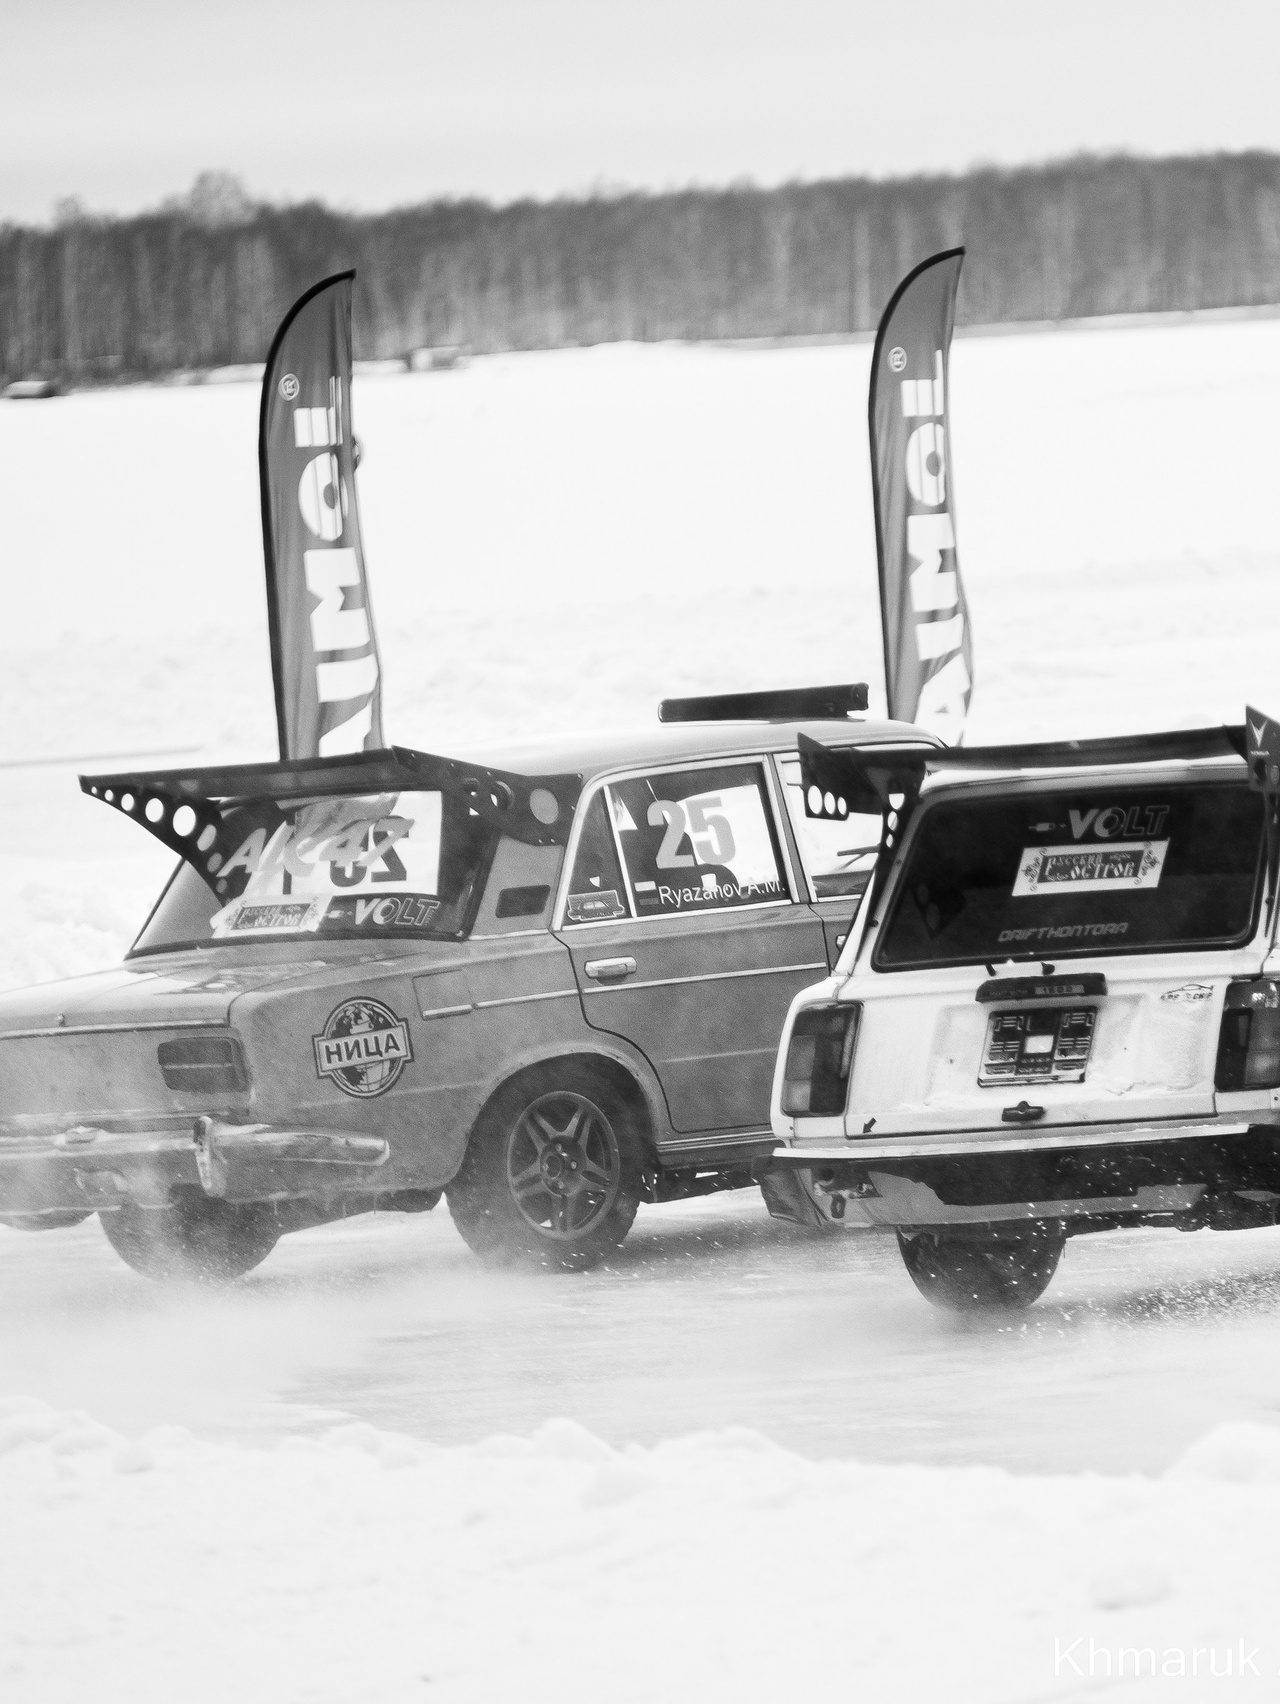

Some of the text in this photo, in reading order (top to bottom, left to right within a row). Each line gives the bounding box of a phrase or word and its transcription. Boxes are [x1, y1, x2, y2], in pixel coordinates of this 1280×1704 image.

[646, 796, 736, 869] 25
[1068, 805, 1171, 839] VOLT
[658, 881, 741, 909] Ryazanov
[354, 898, 441, 926] VOLT
[324, 1032, 401, 1064] НИЦА
